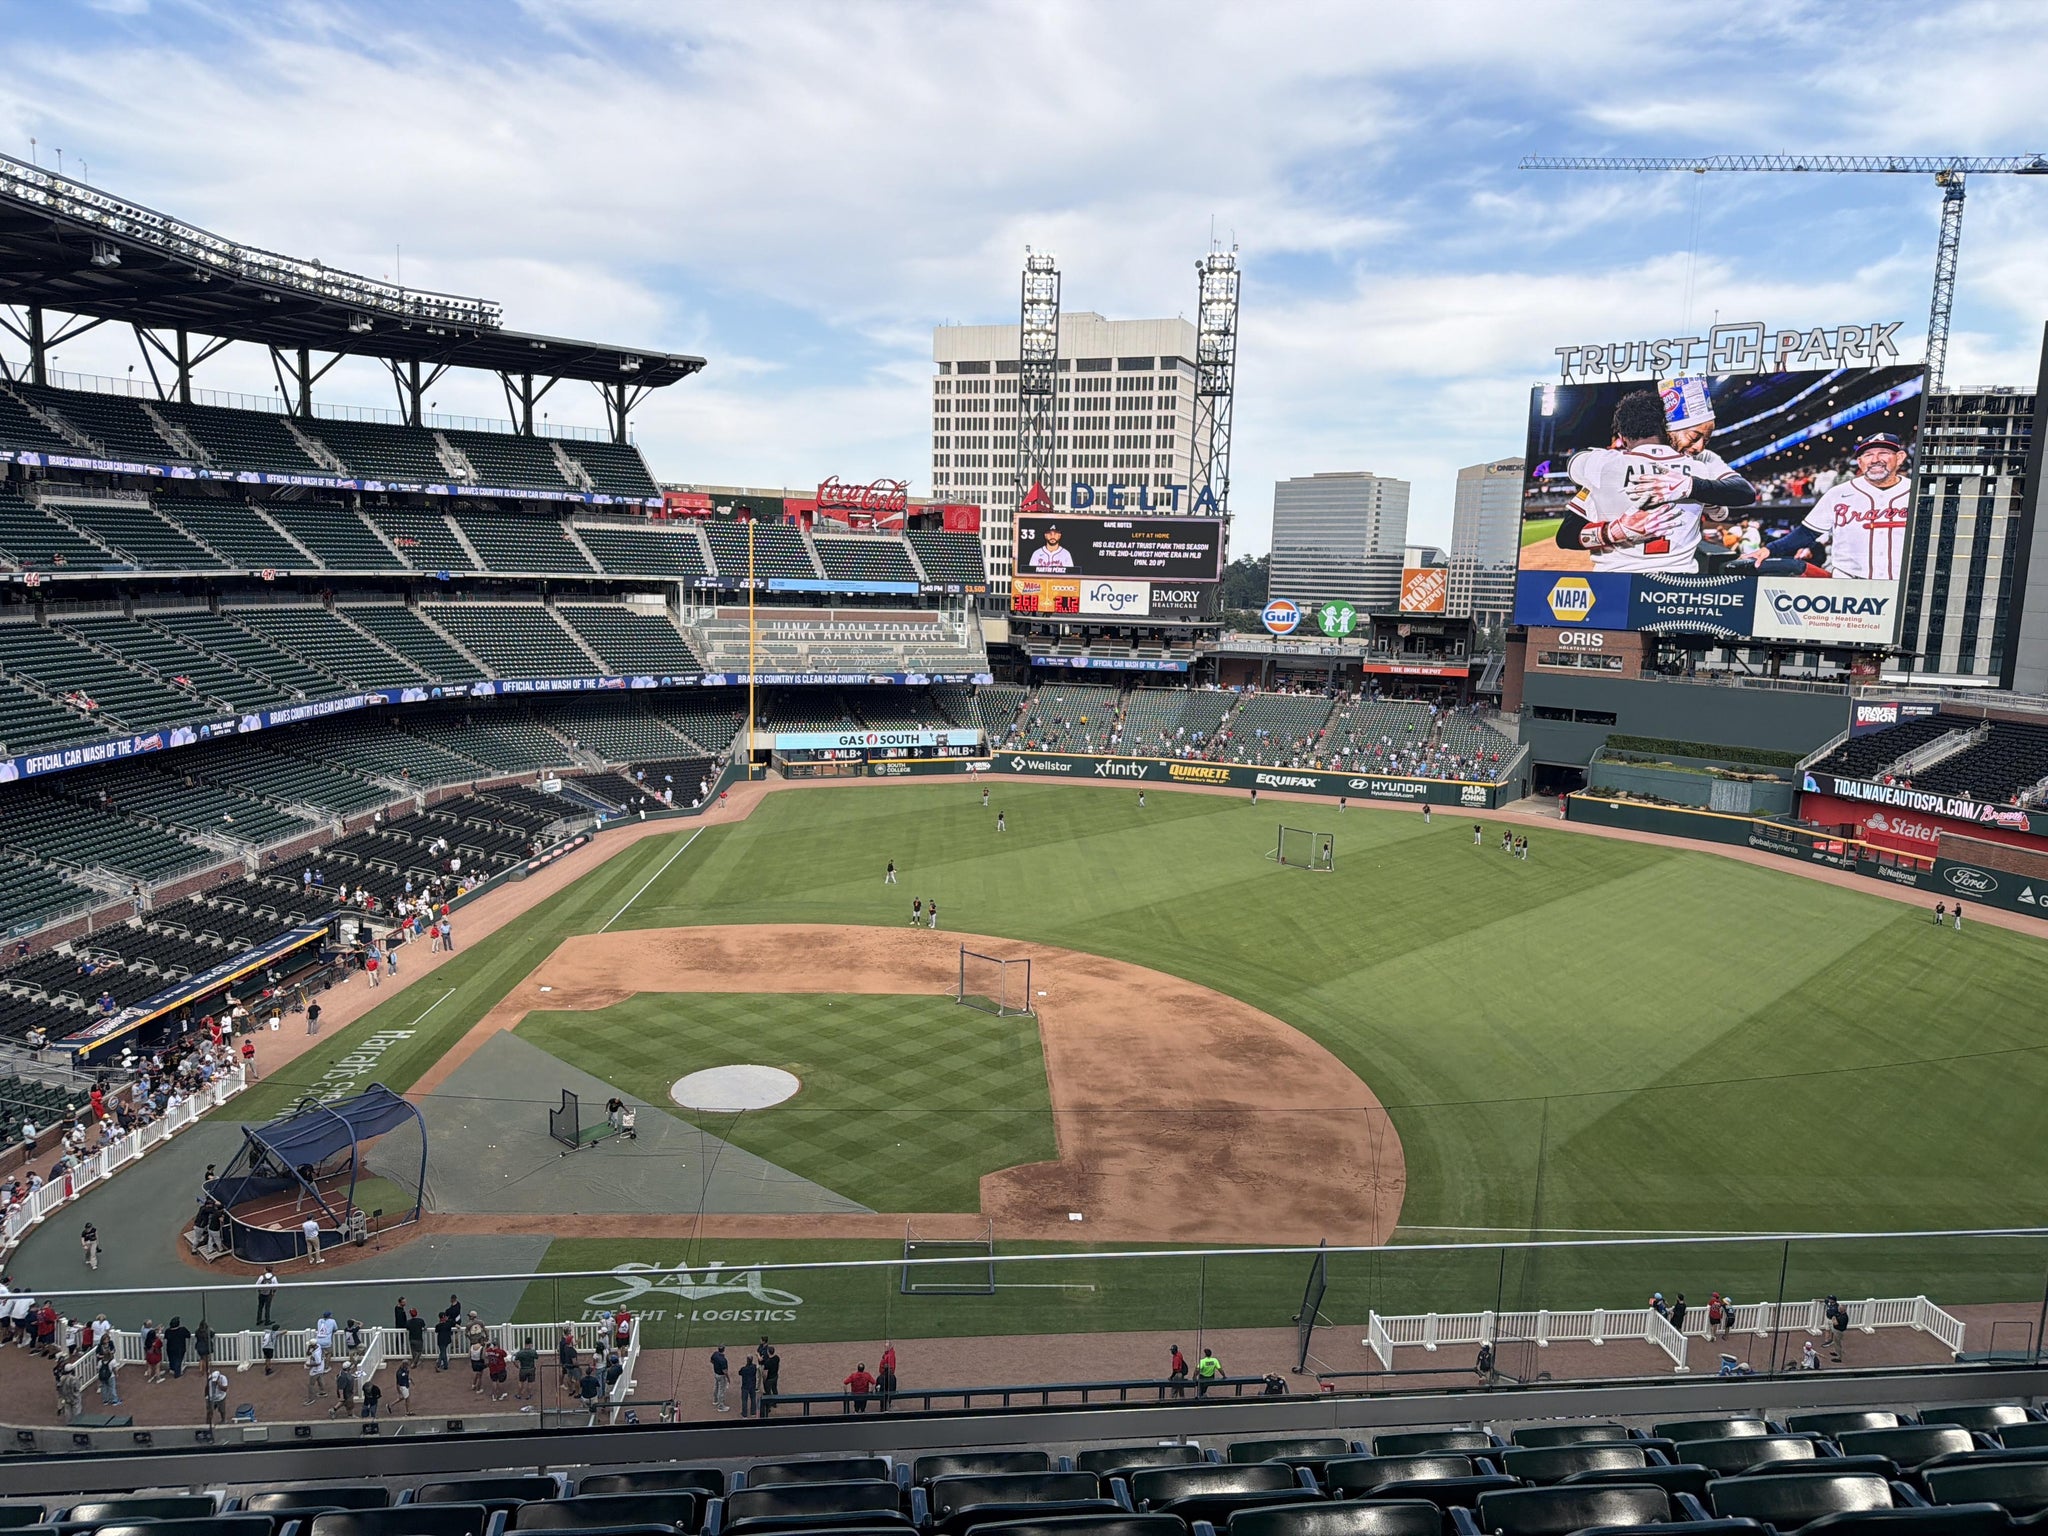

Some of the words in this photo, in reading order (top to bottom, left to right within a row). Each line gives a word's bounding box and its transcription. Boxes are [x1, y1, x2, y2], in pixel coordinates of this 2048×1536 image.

[1555, 337, 1700, 376] TRUIST
[1775, 322, 1904, 363] PARK
[458, 487, 478, 496] BRAVES
[480, 487, 503, 496] COUNTRY
[504, 489, 509, 497] IS
[511, 489, 527, 498] CLEAN
[528, 490, 539, 498] CAR
[539, 491, 562, 500] COUNTRY
[1071, 483, 1219, 511] DELTA
[1020, 529, 1035, 539] 33
[261, 569, 276, 580] 47
[1408, 573, 1425, 590] THE
[1401, 569, 1446, 610] HOME
[1091, 583, 1138, 611] Kroger
[1152, 590, 1200, 602] EMORY
[1417, 587, 1446, 611] DEPOT
[1555, 589, 1587, 609] NAPA
[1640, 591, 1744, 606] NORTHSIDE
[1657, 606, 1723, 616] HOSPITAL
[1773, 595, 1889, 615] COOLRAY
[1265, 611, 1297, 622] Gulf
[1802, 614, 1832, 622] Cooling
[773, 622, 816, 640] HANK
[819, 623, 873, 640] AARON
[874, 624, 946, 641] TERRACE
[1808, 621, 1840, 629] Plumbing
[1847, 622, 1880, 630] Electrical
[1558, 632, 1604, 647] ORIS
[1093, 659, 1113, 667] OFFICIAL
[503, 681, 534, 691] OFFICIAL
[537, 681, 549, 690] CAR
[551, 680, 572, 689] WASH
[573, 680, 581, 689] OF
[583, 679, 595, 688] THE
[765, 675, 793, 684] COUNTRY
[795, 675, 800, 684] IS
[802, 675, 822, 683] CLEAN
[824, 675, 836, 683] CAR
[838, 675, 866, 683] COUNTRY
[270, 711, 290, 724] BRAVES
[291, 707, 313, 722] COUNTRY
[314, 705, 318, 715] IS
[319, 702, 334, 714] CLEAN
[335, 700, 344, 711] CAR
[344, 696, 363, 709] COUNTRY
[1857, 713, 1897, 723] VISION
[210, 723, 223, 731] TIDAL
[224, 720, 235, 728] WAVE
[839, 736, 864, 745] GAS
[880, 735, 919, 745] SOUTH
[26, 754, 64, 774] OFFICIAL
[65, 750, 81, 766] CAR
[83, 745, 105, 762] WASH
[107, 743, 116, 758] OF
[117, 740, 131, 755] THE
[834, 750, 861, 759] MLB+
[898, 749, 922, 757] MB+
[948, 747, 974, 756] MLB+
[1028, 760, 1071, 771] Wellstar
[1095, 761, 1148, 778] xfinity
[1169, 765, 1230, 780] QUIKRETE
[1256, 774, 1317, 787] EQUIFAX
[1371, 782, 1426, 794] HYUNDAI
[1462, 786, 1486, 795] PAPA
[1461, 794, 1486, 802] JOHNS
[1887, 869, 1916, 880] National
[1952, 869, 1988, 889] Ford
[581, 1310, 667, 1321] FRHT
[691, 1310, 796, 1321] LOGISTICS
